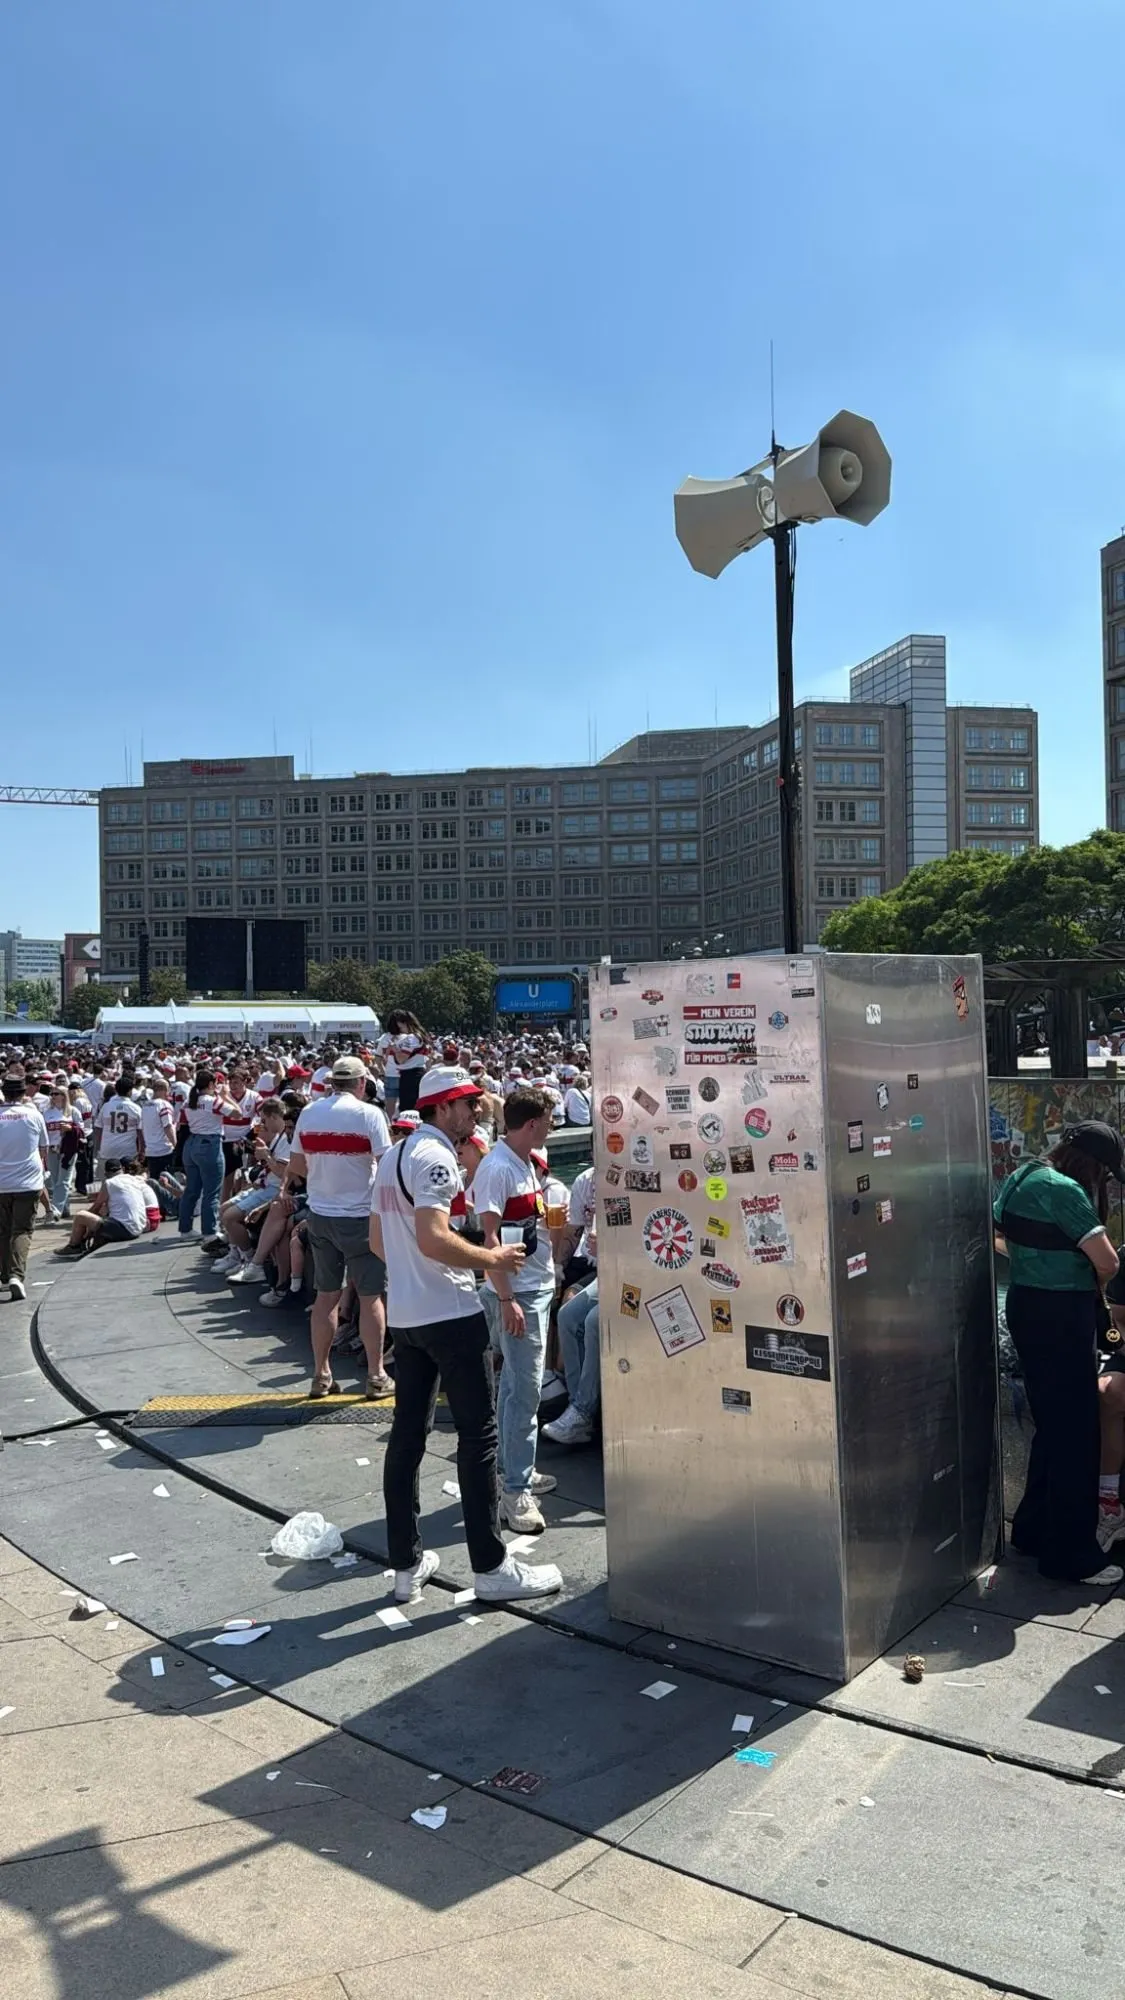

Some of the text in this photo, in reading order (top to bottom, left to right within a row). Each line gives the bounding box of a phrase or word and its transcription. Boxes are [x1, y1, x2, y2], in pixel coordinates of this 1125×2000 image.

[528, 984, 539, 998] U
[700, 1007, 755, 1018] MEIN VEREIN
[685, 1022, 756, 1044] STUTTGART
[685, 1052, 728, 1064] FÜR IMMER
[110, 1112, 128, 1133] 13
[775, 1155, 798, 1164] Moin
